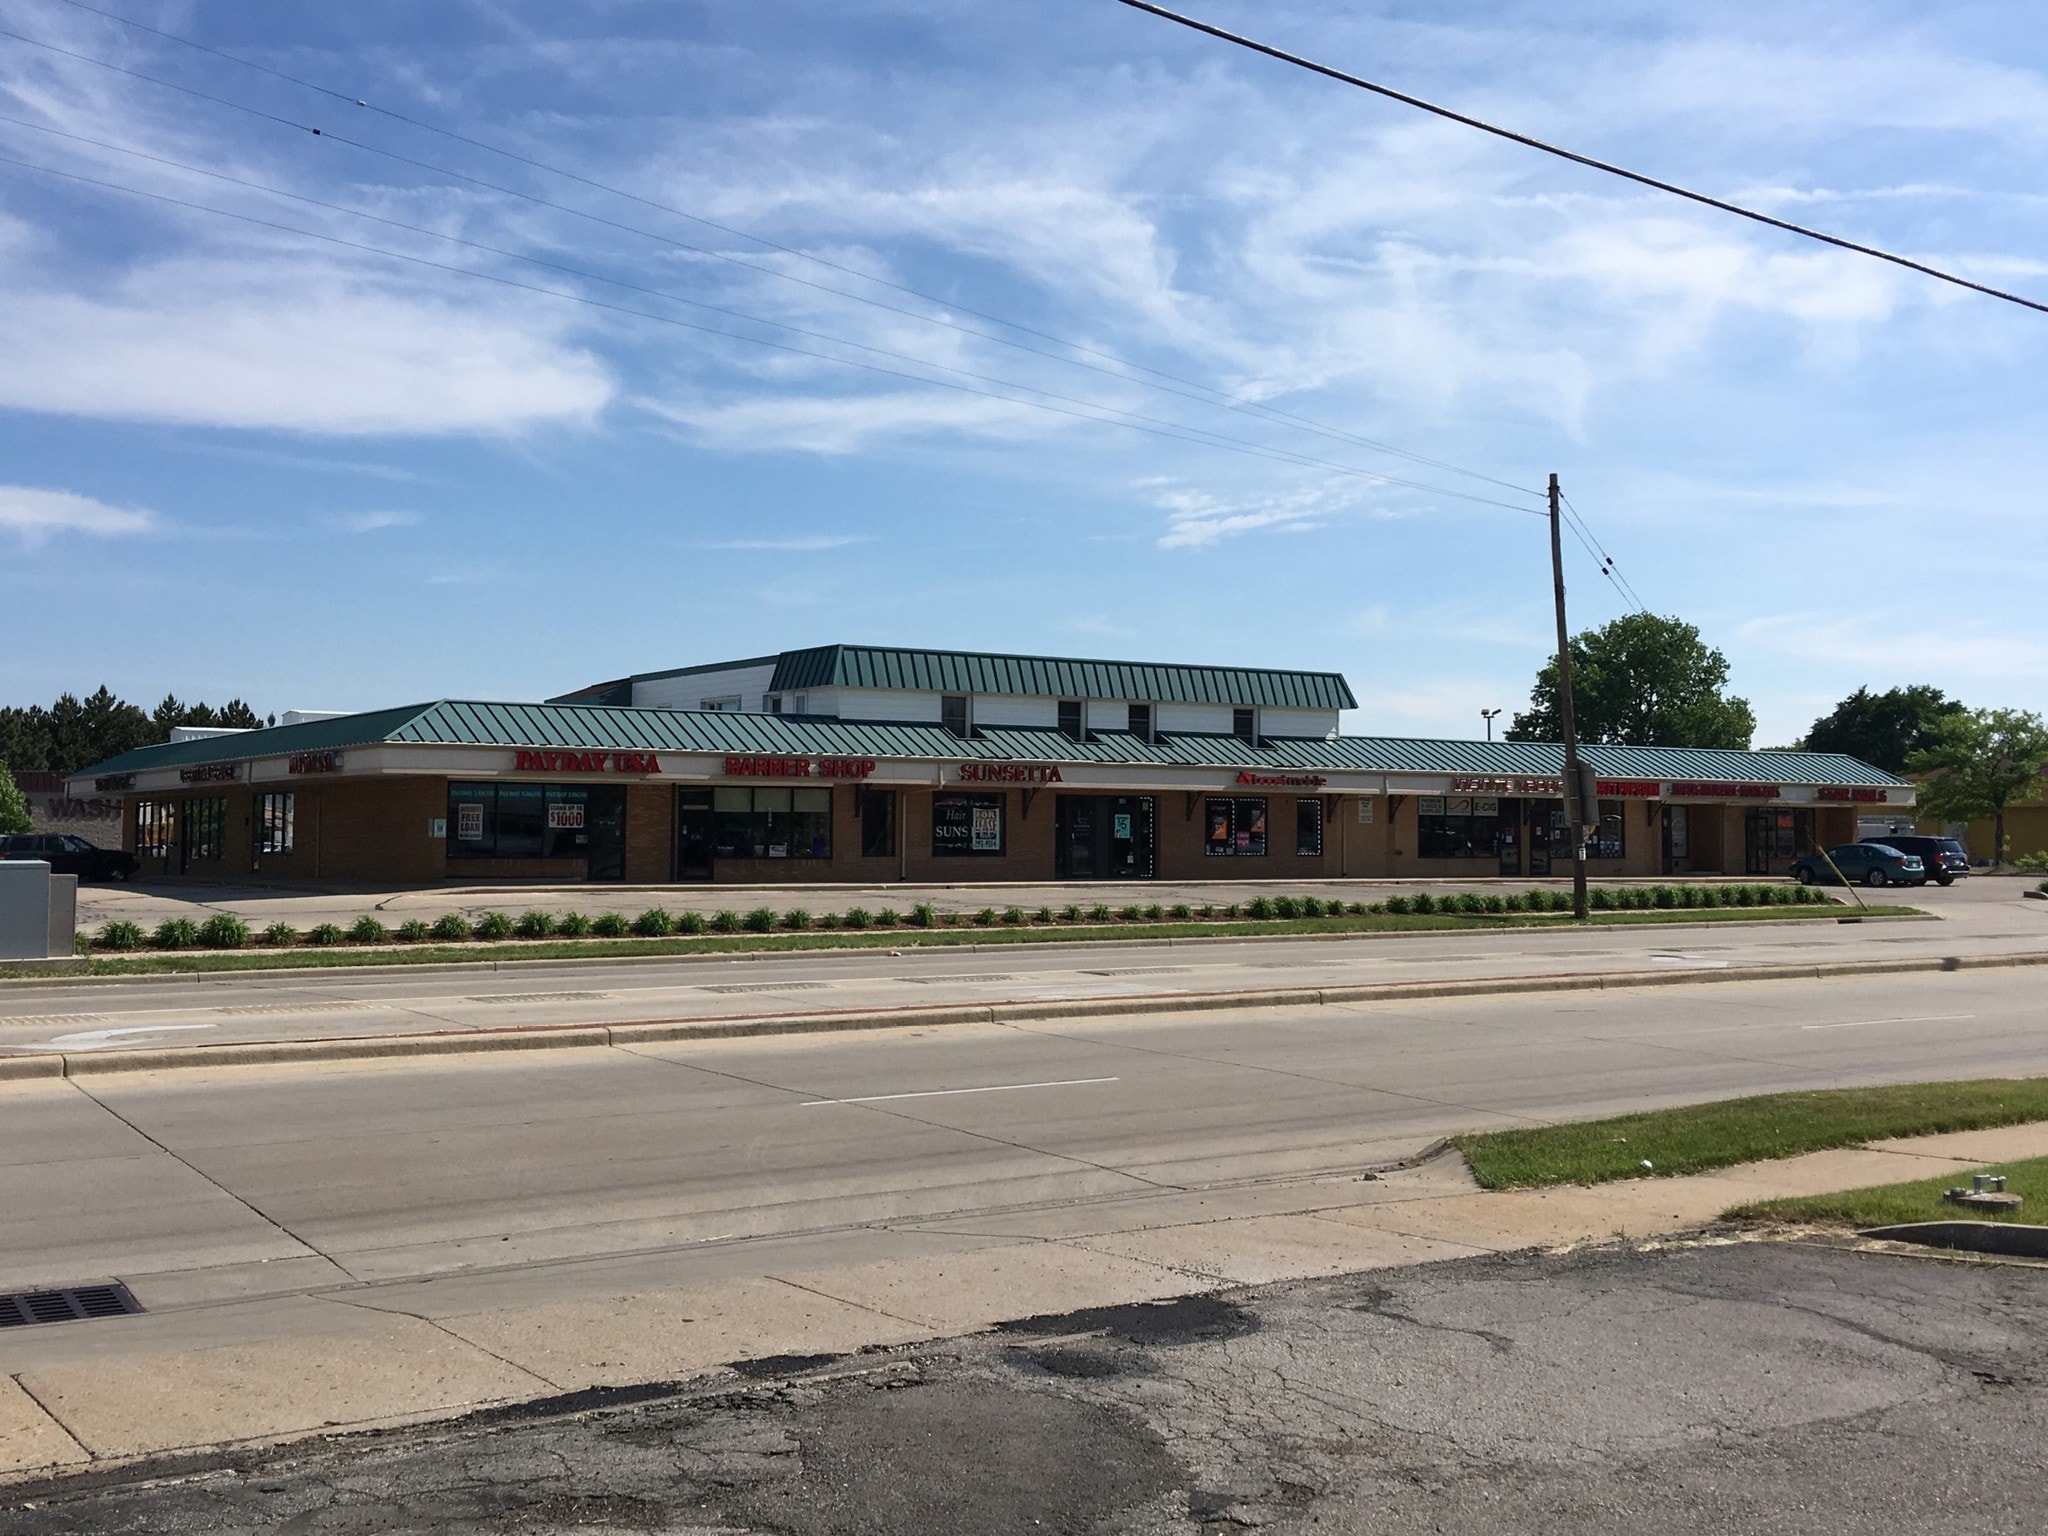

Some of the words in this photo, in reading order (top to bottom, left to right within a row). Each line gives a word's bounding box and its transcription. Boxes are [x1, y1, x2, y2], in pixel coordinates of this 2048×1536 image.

[514, 751, 610, 772] PAYDAY
[612, 753, 662, 774] USA
[725, 757, 811, 777] BARBER
[818, 759, 876, 778] SHOP
[960, 763, 1064, 783] SUNSETTA
[48, 798, 122, 819] WASH
[946, 809, 967, 820] Hair
[461, 813, 481, 822] FREE
[550, 811, 583, 826] $1000
[460, 822, 480, 832] LOAN
